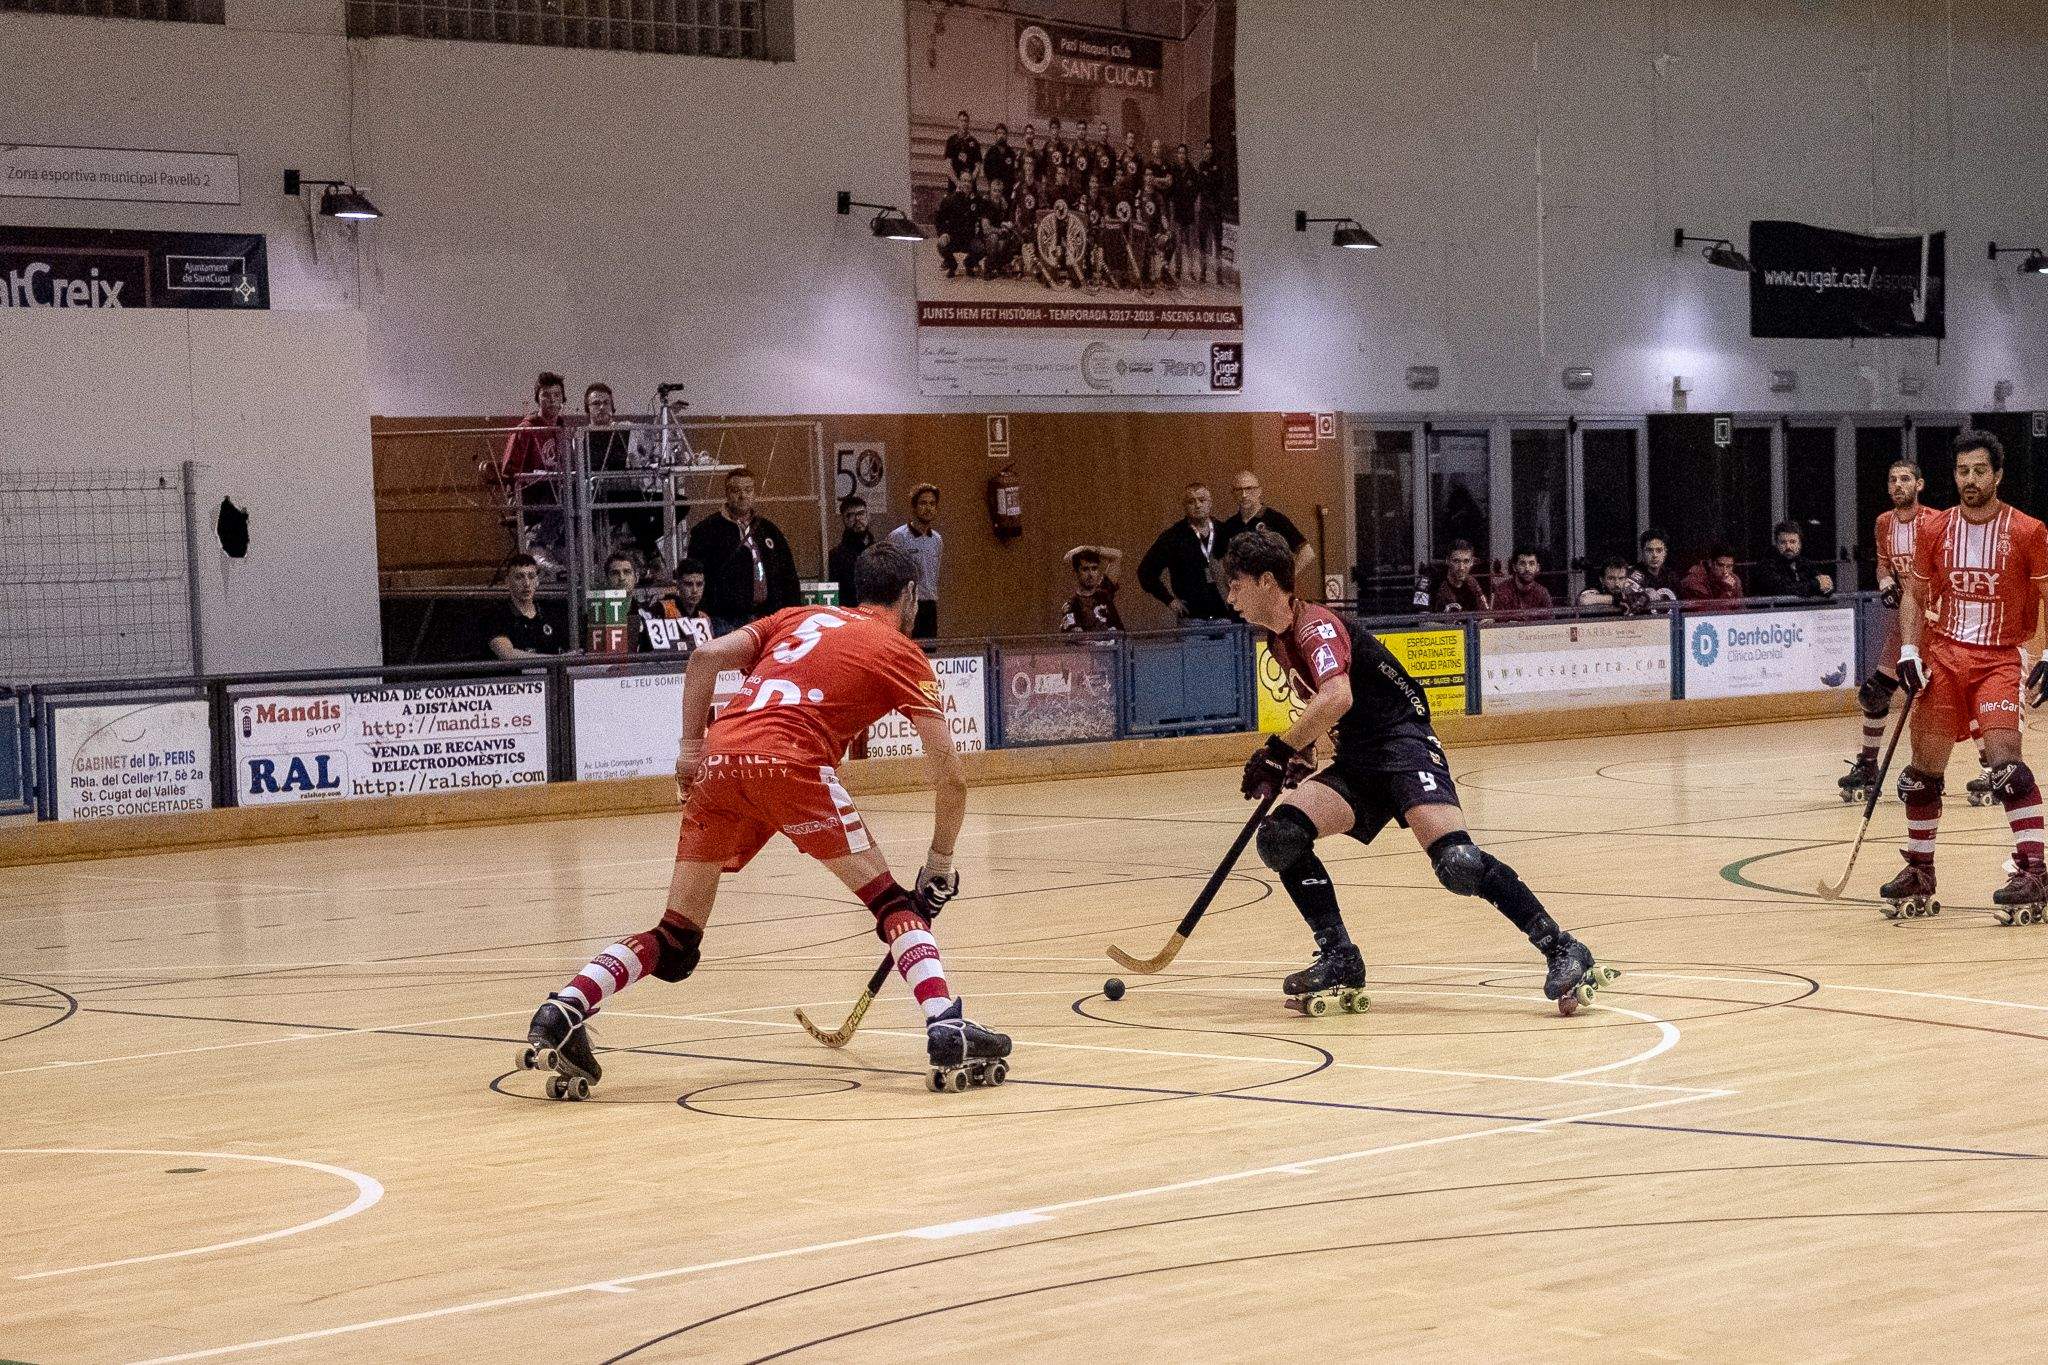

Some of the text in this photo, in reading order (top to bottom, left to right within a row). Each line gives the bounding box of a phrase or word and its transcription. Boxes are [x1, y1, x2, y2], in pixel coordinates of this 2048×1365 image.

[1061, 59, 1155, 87] SANT CUGAT
[7, 167, 39, 181] Zona
[41, 169, 97, 185] esportiva
[99, 170, 157, 187] municipal
[203, 175, 211, 187] 2
[183, 274, 195, 284] de
[185, 263, 229, 275] Ajuntament
[922, 308, 954, 320] JUNTS
[956, 308, 979, 320] HEM
[981, 308, 997, 320] FET
[1049, 309, 1109, 321] TEMPORADA
[1110, 309, 1155, 322] 2017-2018
[1161, 310, 1195, 322] ASCENS
[1216, 311, 1237, 323] LIGA
[610, 602, 623, 622] T
[611, 630, 623, 651] F
[1407, 635, 1458, 648] ESPECIALISTES
[1727, 623, 1803, 649] Dentalògic
[935, 659, 979, 675] CLINIC
[1439, 658, 1463, 669] PATINS
[620, 680, 632, 689] EL
[634, 678, 652, 688] TEU
[654, 675, 685, 687] SOMRI
[350, 682, 543, 704] VENDA DE COMANDAMENTS
[1394, 676, 1415, 698] SANT
[1410, 695, 1426, 716] CUG
[256, 700, 342, 725] Mandis
[402, 703, 412, 716] A
[361, 712, 533, 739] http://mandis.es
[371, 737, 517, 759] VENDA DE RECANVIS
[76, 749, 196, 773] GABINET del Dr. PERIS
[71, 776, 99, 789] Rbla.
[102, 774, 120, 786] del
[122, 772, 154, 785] Celler
[248, 754, 341, 794] RAL
[352, 768, 546, 798] http://ralshop.com
[708, 767, 790, 780] FACILITY
[81, 784, 188, 803] St. Cugat del Vallès
[301, 790, 342, 800] ralshop.com
[73, 797, 205, 819] HORES CONCERTADES
